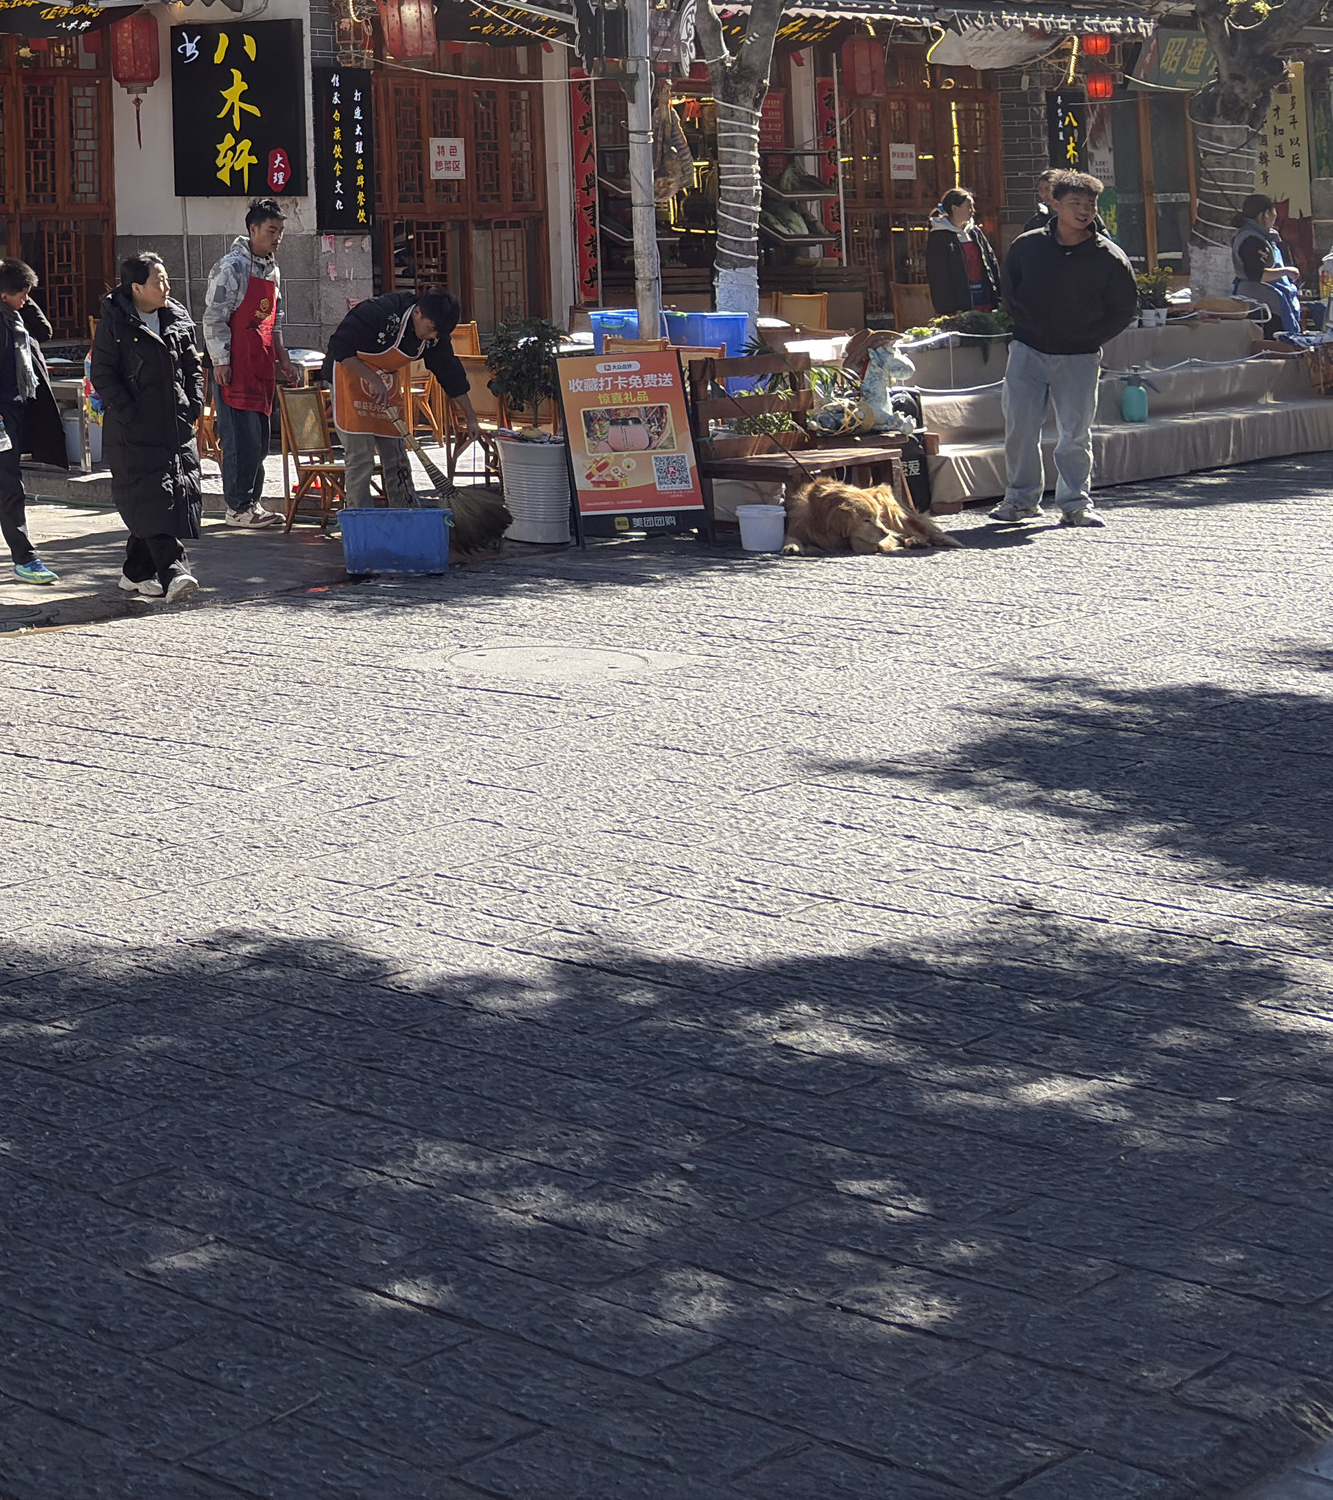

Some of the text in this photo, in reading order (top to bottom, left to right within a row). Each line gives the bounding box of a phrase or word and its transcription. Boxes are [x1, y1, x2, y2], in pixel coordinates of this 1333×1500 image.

[214, 32, 261, 194] 八木轩
[436, 145, 458, 157] 特色
[1064, 111, 1079, 174] 八木
[273, 154, 285, 185] 大理
[568, 373, 673, 392] 收藏打卡免费送
[598, 391, 650, 404] 惊喜礼品
[632, 515, 676, 528] 美团团购
